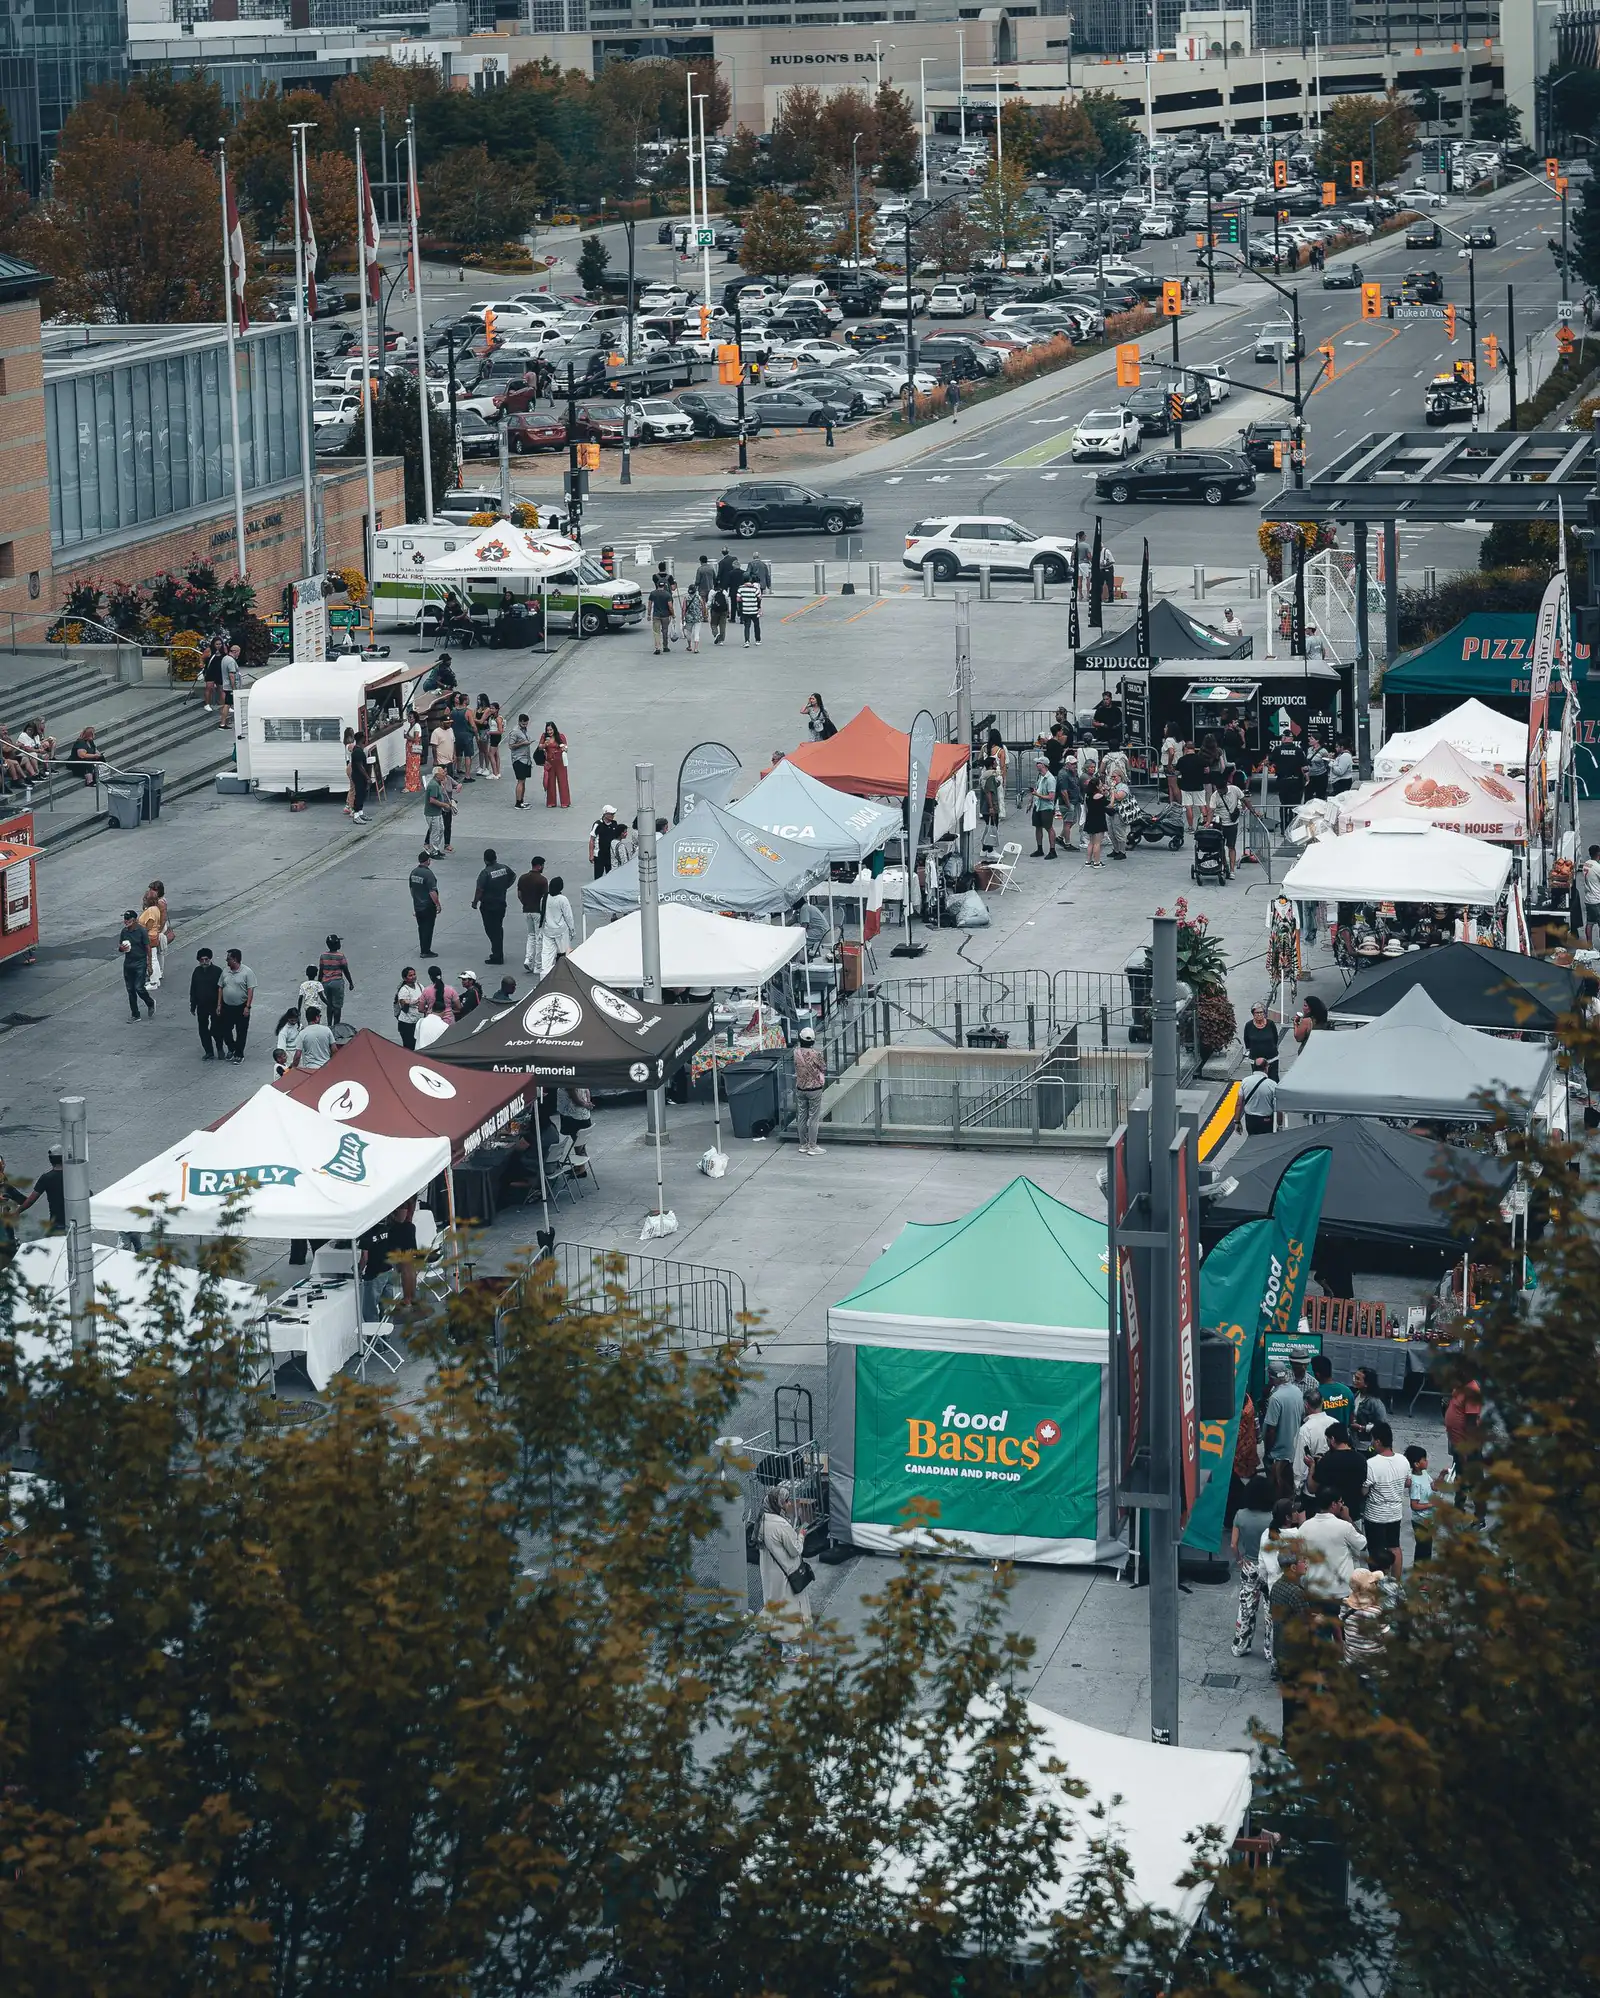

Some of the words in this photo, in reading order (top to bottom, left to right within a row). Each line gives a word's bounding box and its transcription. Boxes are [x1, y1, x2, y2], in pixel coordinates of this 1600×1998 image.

[770, 53, 849, 65] HUDSON'S
[854, 53, 885, 63] BAY
[700, 232, 711, 242] P3
[1397, 309, 1418, 317] Duke
[1420, 308, 1428, 317] of
[1559, 308, 1571, 317] 40
[961, 545, 1009, 555] POLICE
[1543, 613, 1552, 640] HEY
[1086, 656, 1149, 669] SPIDUCCI
[1538, 644, 1550, 684] JUICE
[1262, 696, 1307, 705] SPIDUCCI
[686, 767, 708, 775] Credit
[850, 806, 882, 832] DUCA
[760, 825, 816, 839] UCA
[1464, 823, 1504, 833] HOUSE
[505, 1038, 533, 1046] Arbor
[536, 1038, 583, 1047] Memorial
[493, 1064, 523, 1073] Arbor
[525, 1064, 576, 1076] Memorial
[331, 1135, 362, 1178] RALLY
[1329, 1394, 1343, 1402] food
[942, 1405, 1009, 1432] food
[905, 1463, 959, 1477] CANADIAN
[960, 1469, 983, 1479] AND
[985, 1471, 1021, 1482] PROUD
